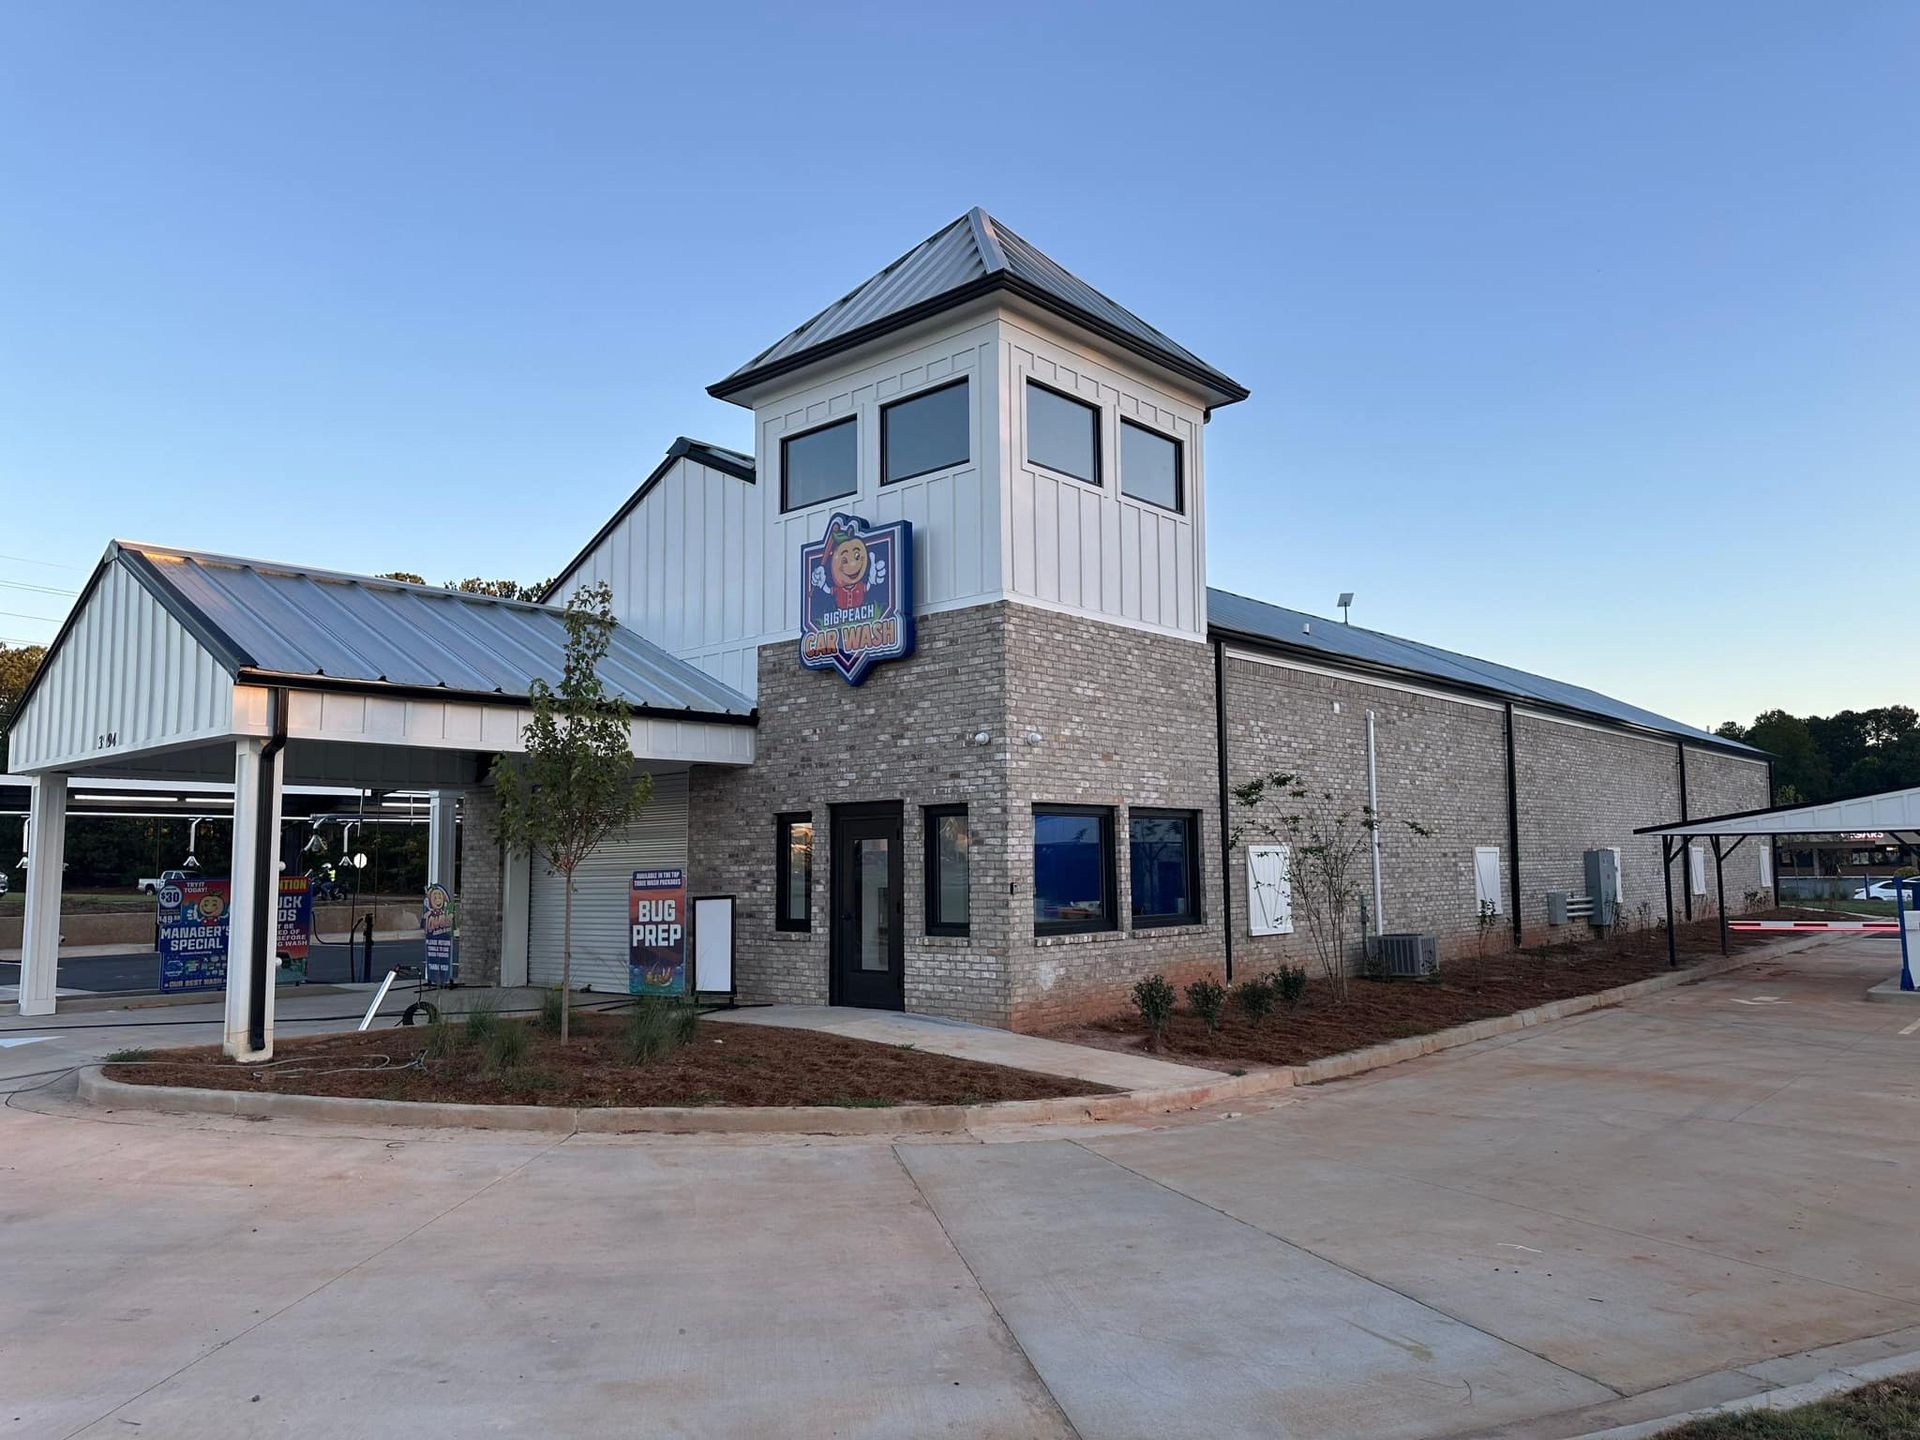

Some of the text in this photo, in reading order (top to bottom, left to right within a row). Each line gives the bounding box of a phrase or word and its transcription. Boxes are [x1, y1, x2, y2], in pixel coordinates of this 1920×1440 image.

[823, 604, 875, 626] BIG PEACH
[804, 619, 896, 658] CAR WASH
[160, 891, 180, 903] $30
[638, 899, 676, 922] BUG
[160, 925, 230, 940] MANAGER'S
[632, 924, 682, 947] PREP
[170, 937, 224, 951] SPECIAL
